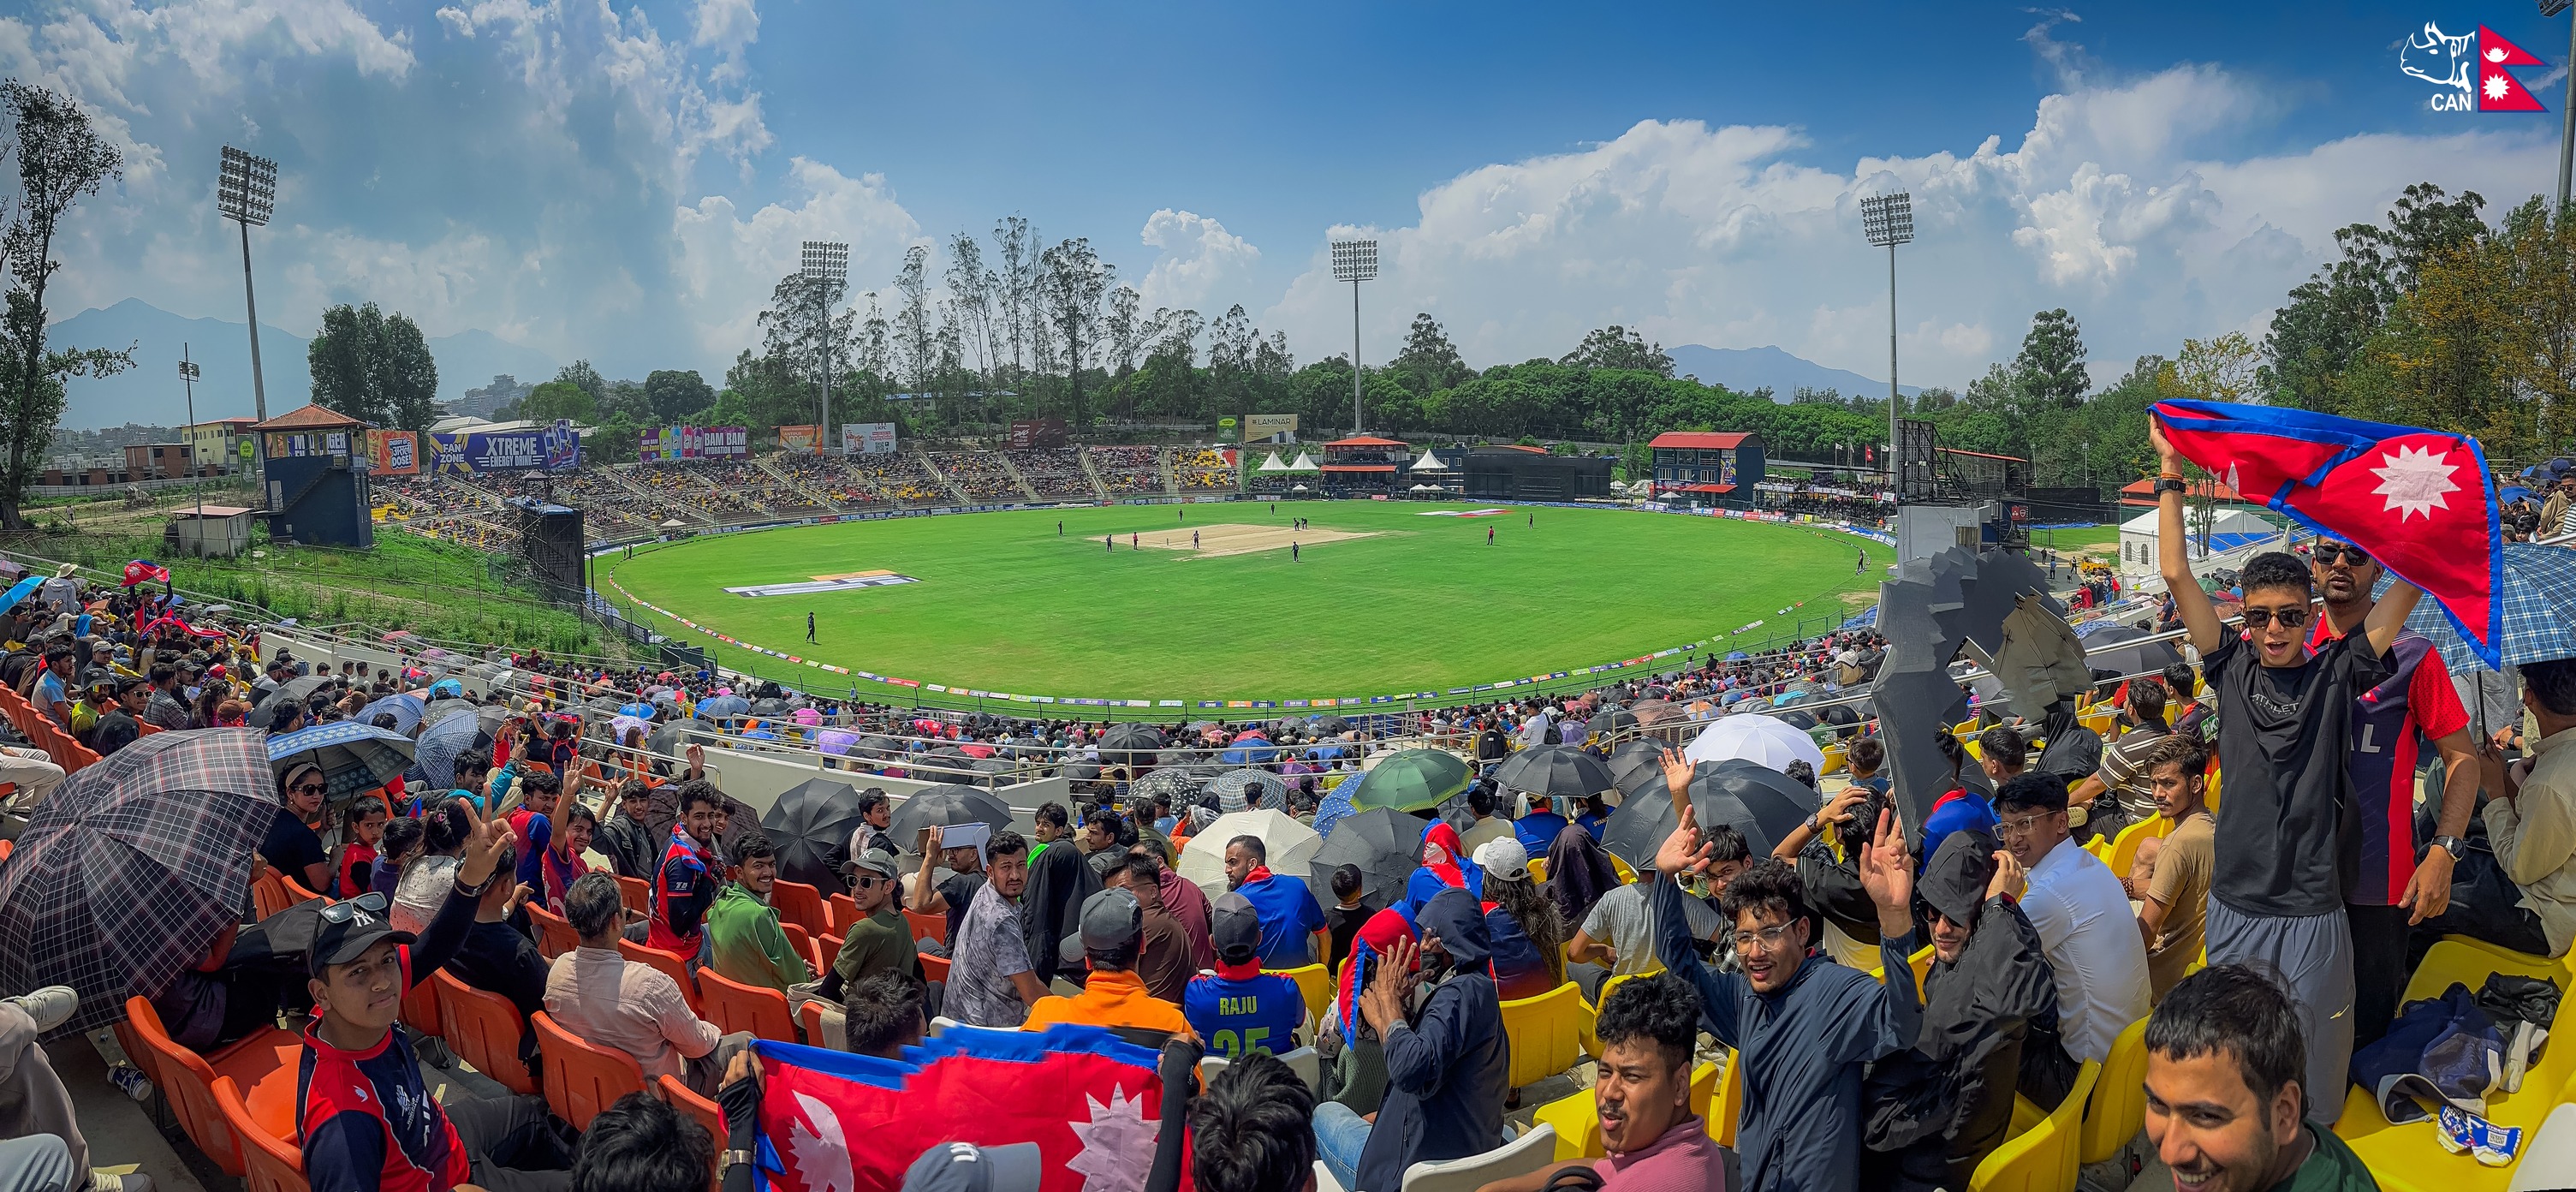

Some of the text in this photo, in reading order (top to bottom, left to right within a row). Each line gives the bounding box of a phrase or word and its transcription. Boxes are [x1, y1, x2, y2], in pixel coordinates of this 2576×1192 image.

[705, 432, 724, 446] BAM
[726, 432, 746, 445] BAM
[443, 444, 461, 453] FAN
[485, 438, 537, 456] XTREME
[705, 445, 747, 455] HYDRATION DRINK
[391, 456, 412, 467] DOSE!
[440, 454, 465, 463] ZONE
[490, 456, 532, 467] ENERGY DRINK
[1219, 995, 1258, 1016] RAJU
